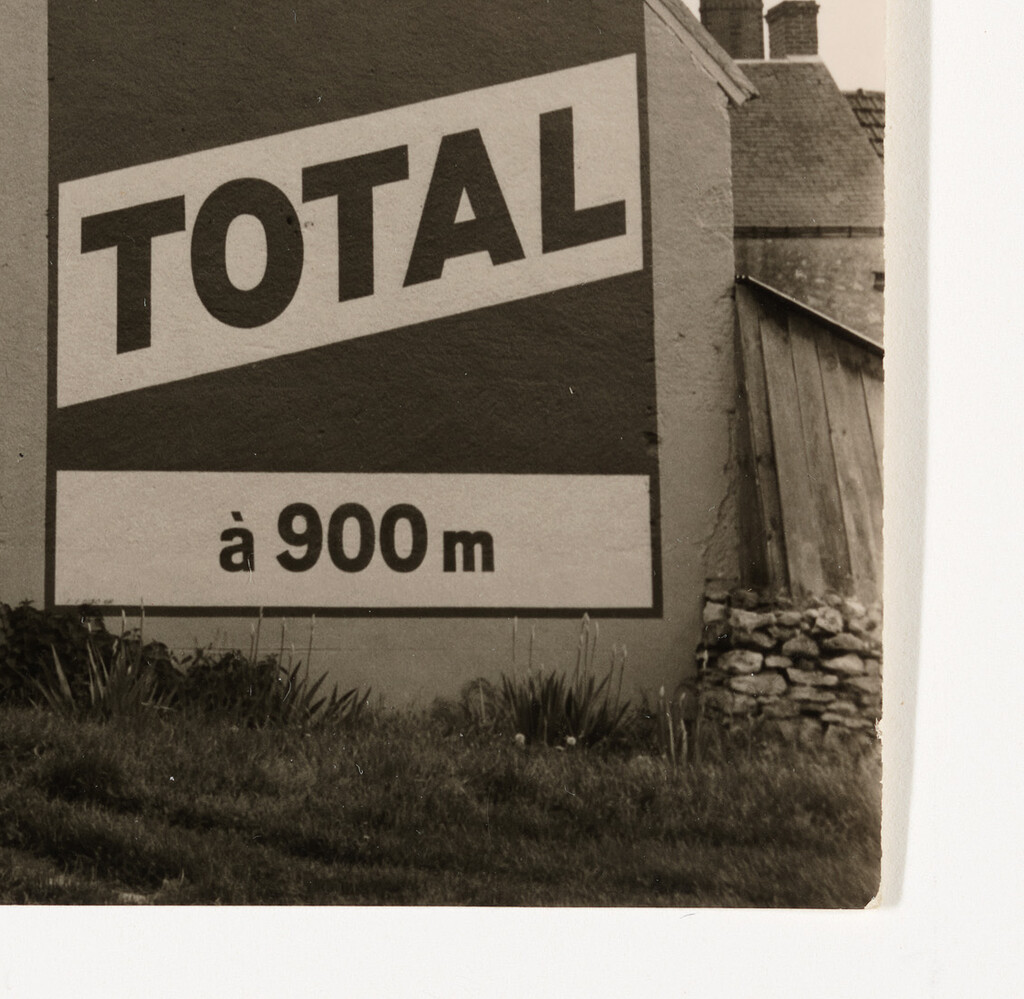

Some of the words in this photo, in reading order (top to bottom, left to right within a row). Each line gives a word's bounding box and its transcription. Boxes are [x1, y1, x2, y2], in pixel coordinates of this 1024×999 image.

[80, 106, 627, 355] TOTAL
[219, 511, 255, 572] à
[276, 502, 428, 573] 900
[442, 528, 495, 572] m
